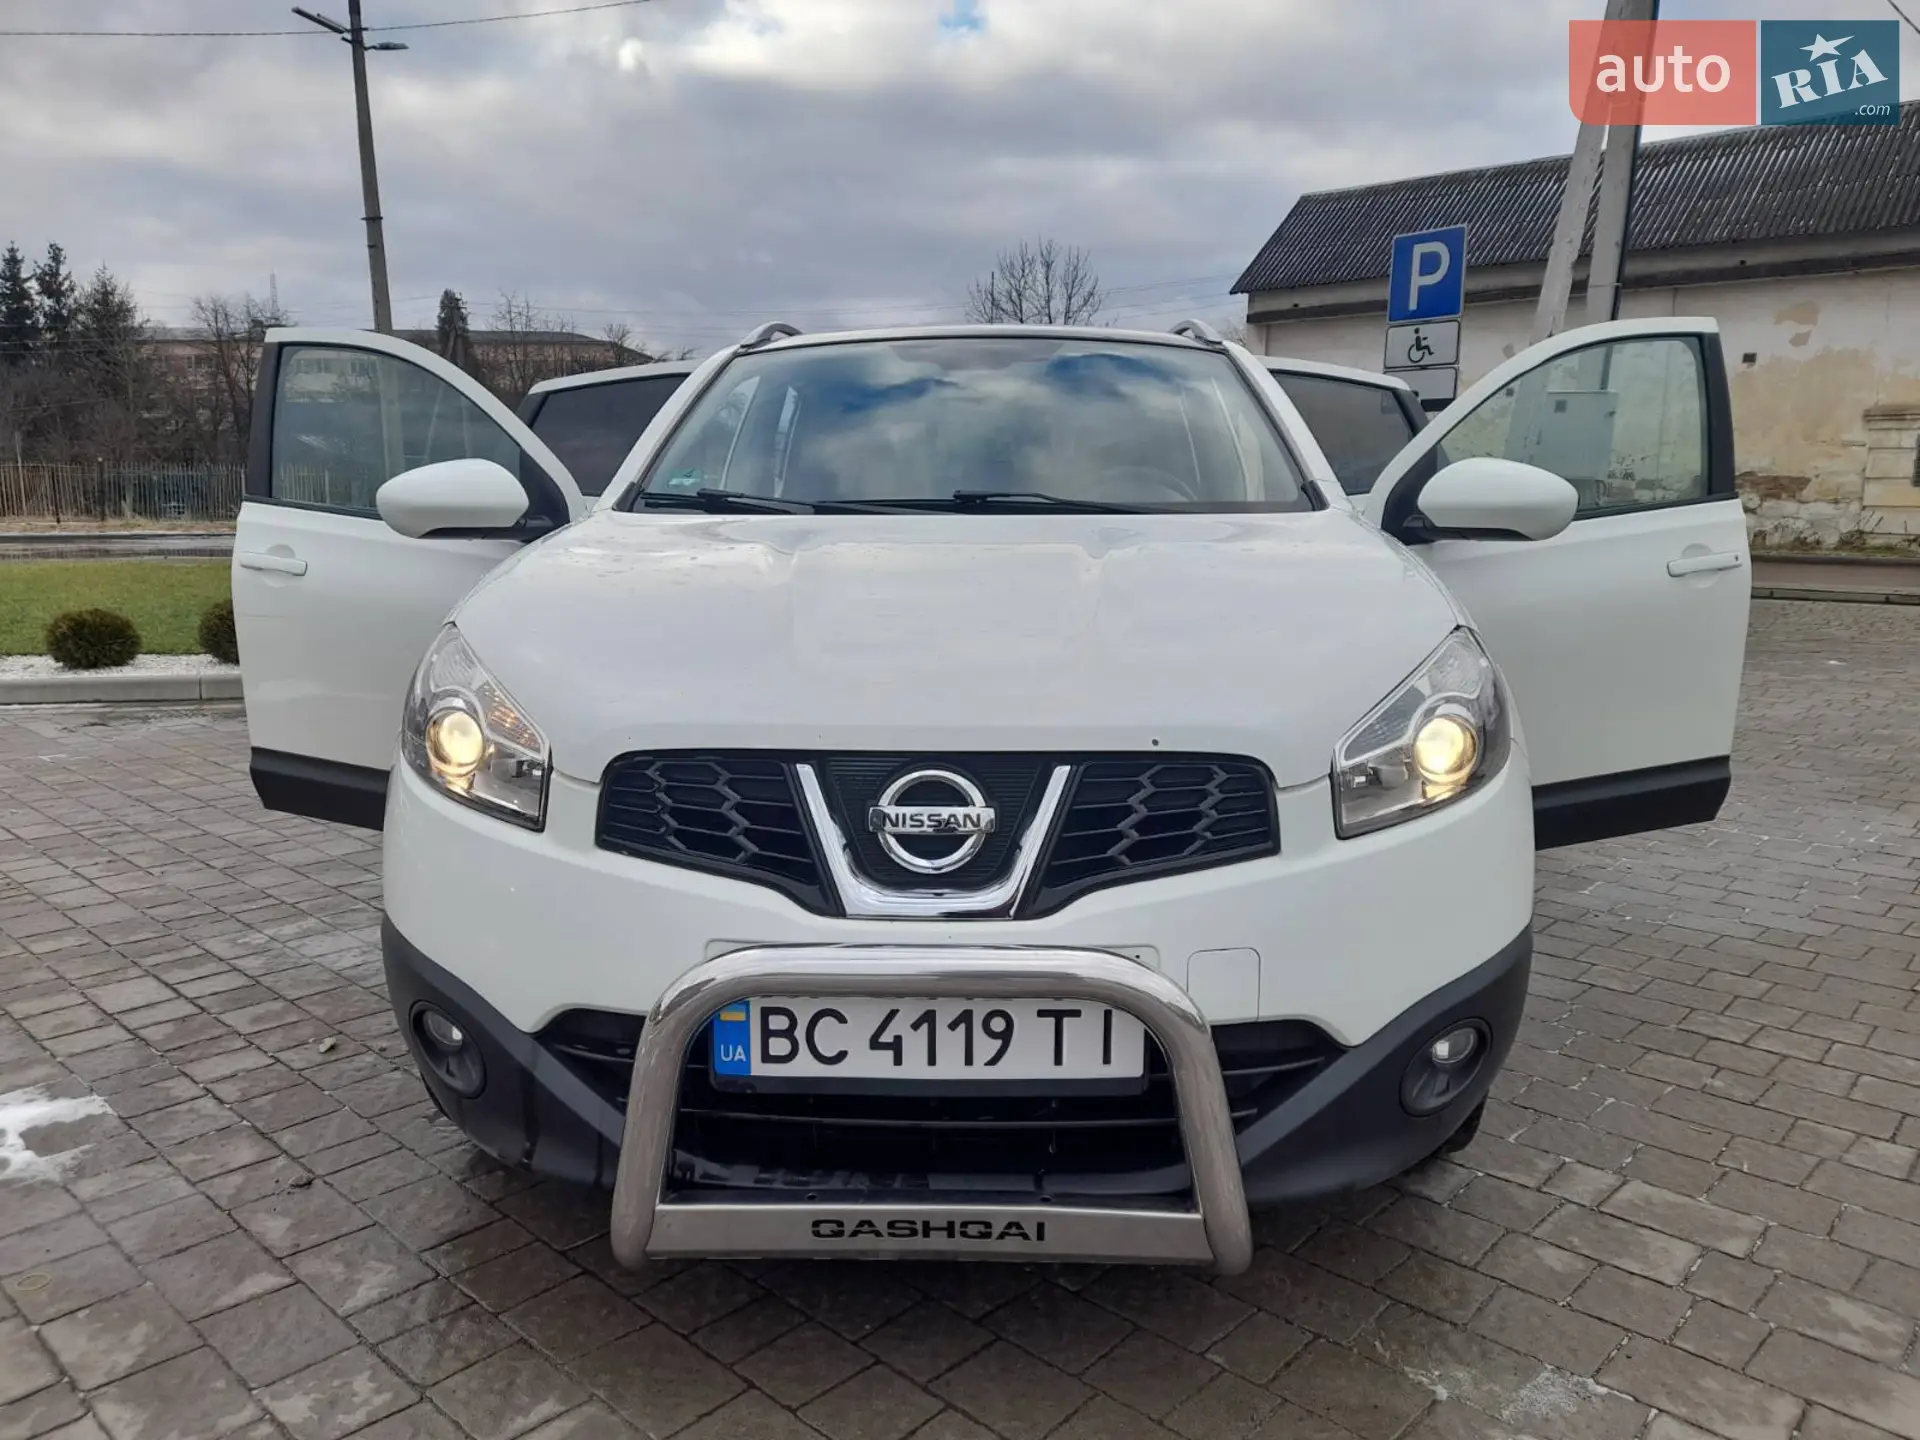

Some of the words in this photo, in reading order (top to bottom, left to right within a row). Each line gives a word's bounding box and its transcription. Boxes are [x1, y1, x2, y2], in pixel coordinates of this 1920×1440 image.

[1408, 241, 1450, 311] P
[882, 813, 981, 829] NISSAN
[760, 1006, 848, 1066] BC
[869, 1008, 1014, 1066] 4119
[1037, 1009, 1113, 1066] TI
[720, 1044, 747, 1062] UA
[811, 1219, 1046, 1242] QASHQAI
